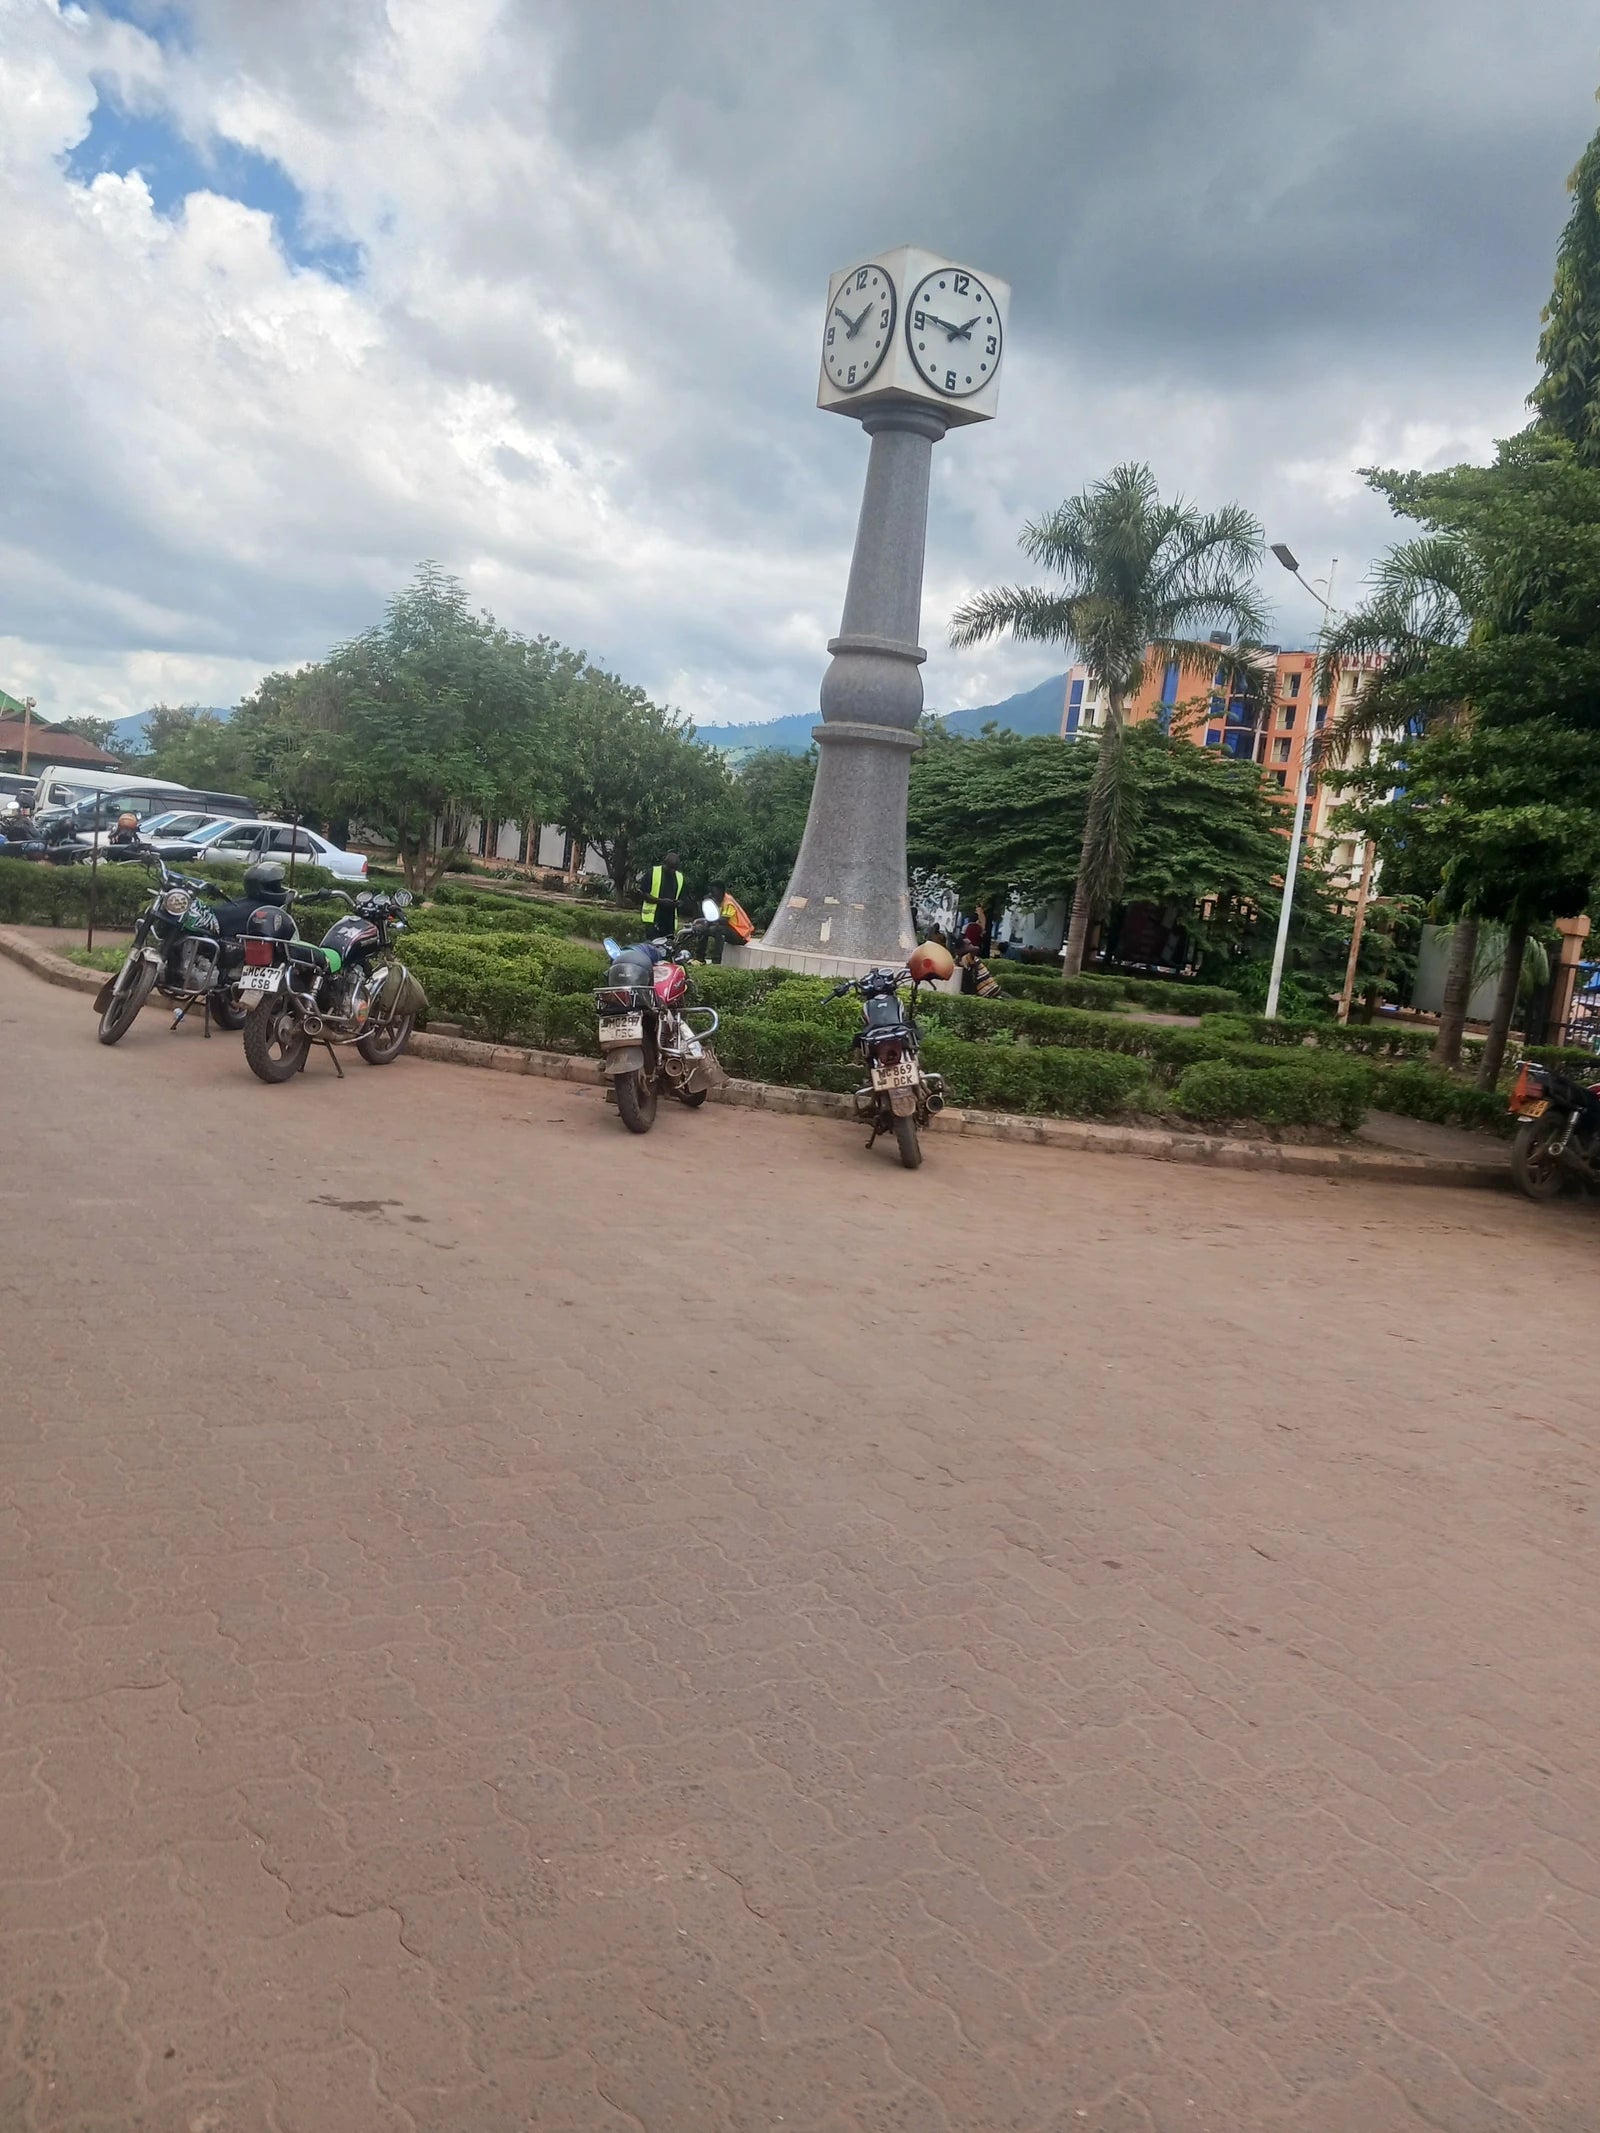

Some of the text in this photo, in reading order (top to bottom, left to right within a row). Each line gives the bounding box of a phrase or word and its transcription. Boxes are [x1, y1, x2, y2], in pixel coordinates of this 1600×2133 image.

[856, 270, 868, 290] 12
[954, 274, 970, 295] 12
[880, 309, 889, 329] 3
[914, 311, 926, 331] 9
[827, 327, 836, 346] 9
[986, 335, 997, 355] 3
[847, 365, 857, 385] 6
[945, 371, 957, 391] 6
[251, 979, 270, 990] CSB
[894, 1076, 913, 1087] DCK
